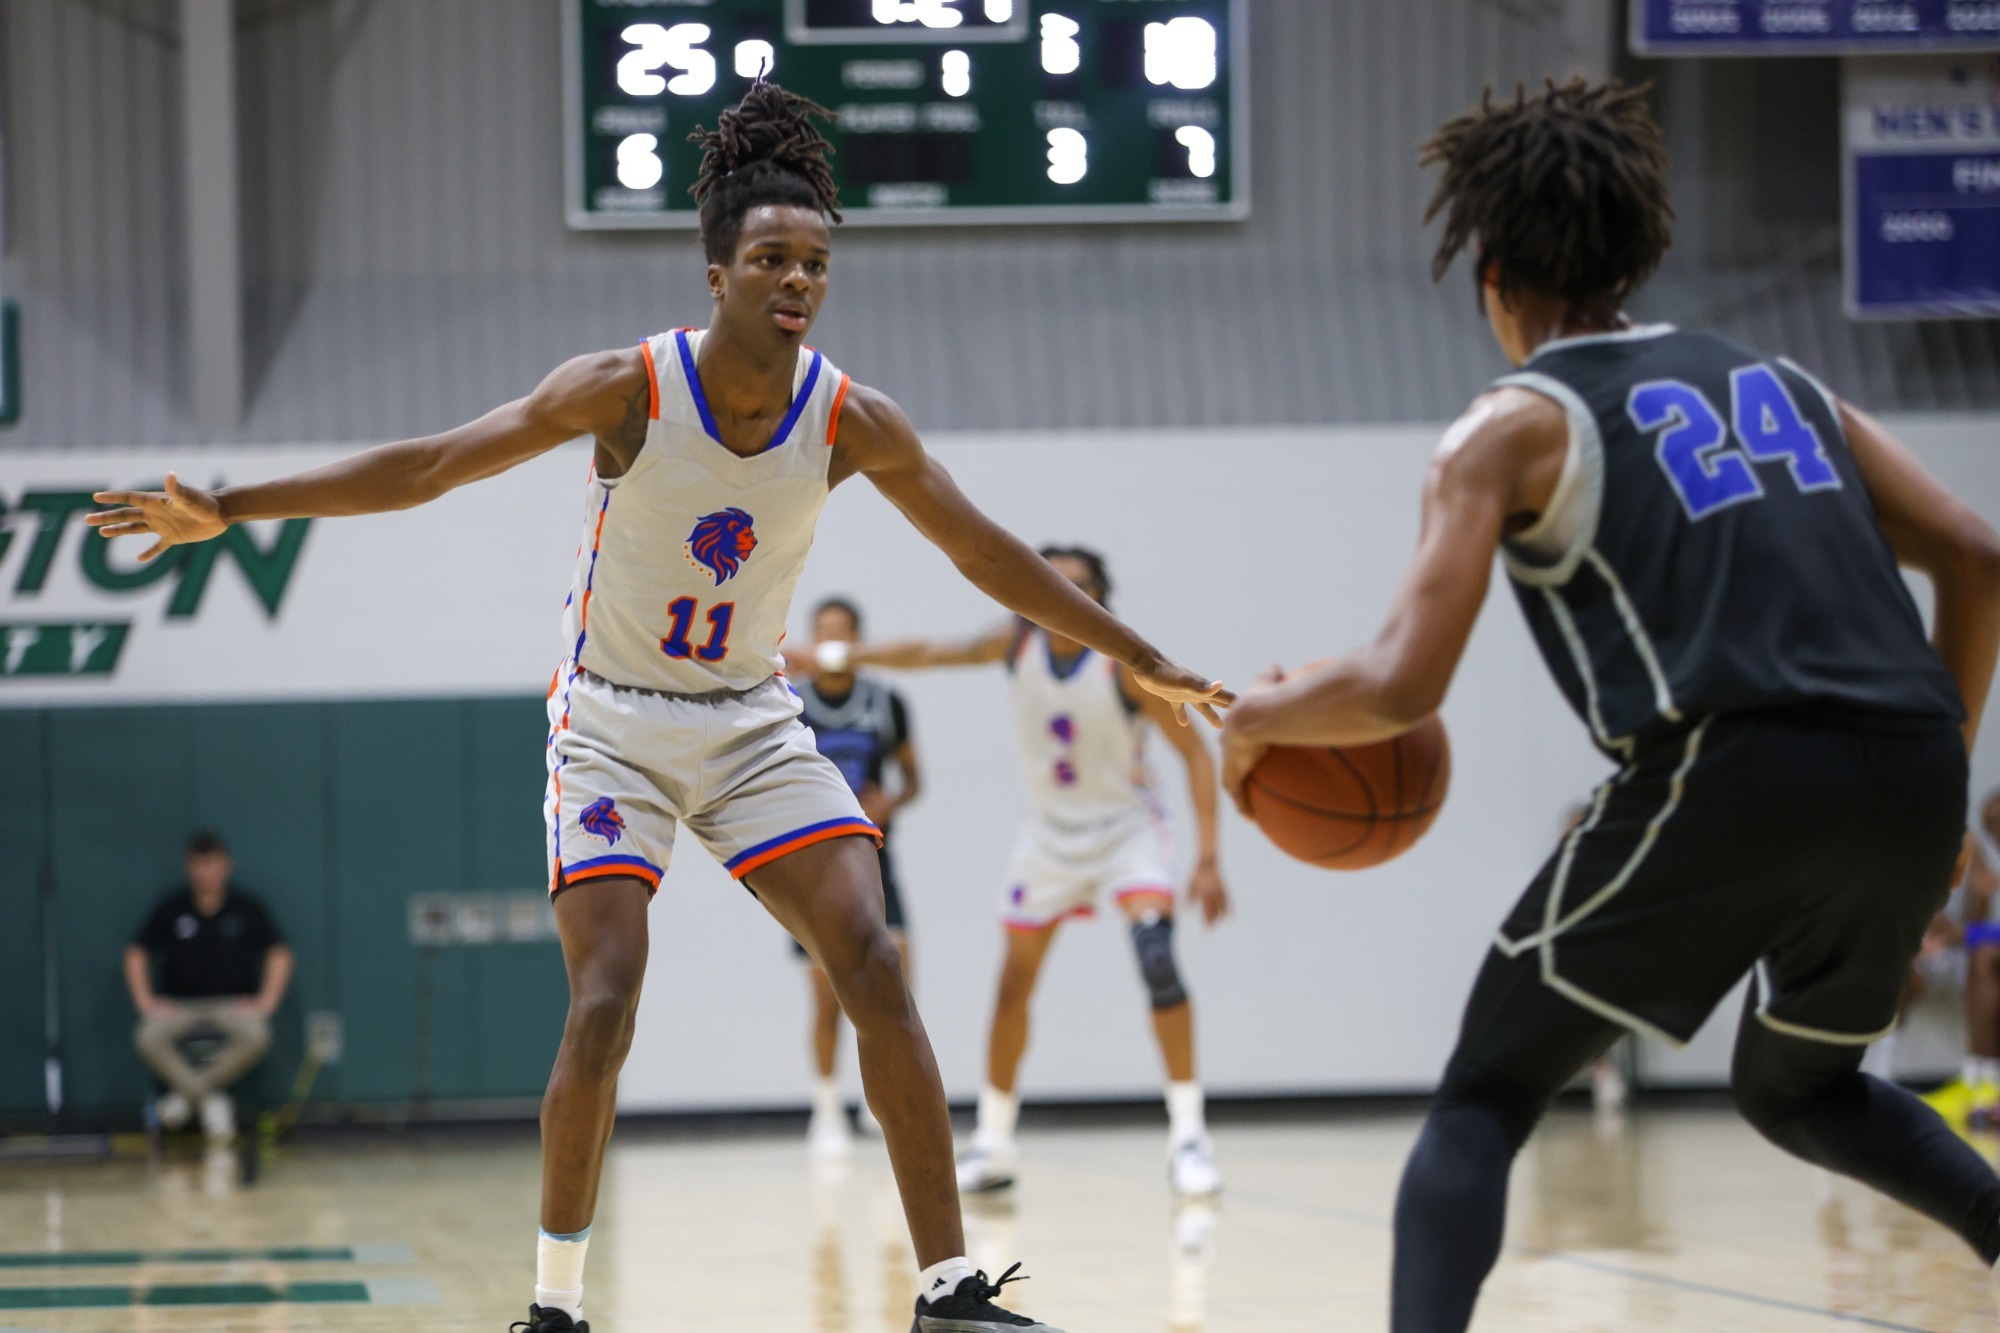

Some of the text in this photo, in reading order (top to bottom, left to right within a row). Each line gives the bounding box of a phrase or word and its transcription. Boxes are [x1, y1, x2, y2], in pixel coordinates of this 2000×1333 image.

[616, 23, 716, 96] 25
[1046, 127, 1088, 185] 3
[1625, 362, 1843, 524] 24
[660, 595, 735, 663] 11
